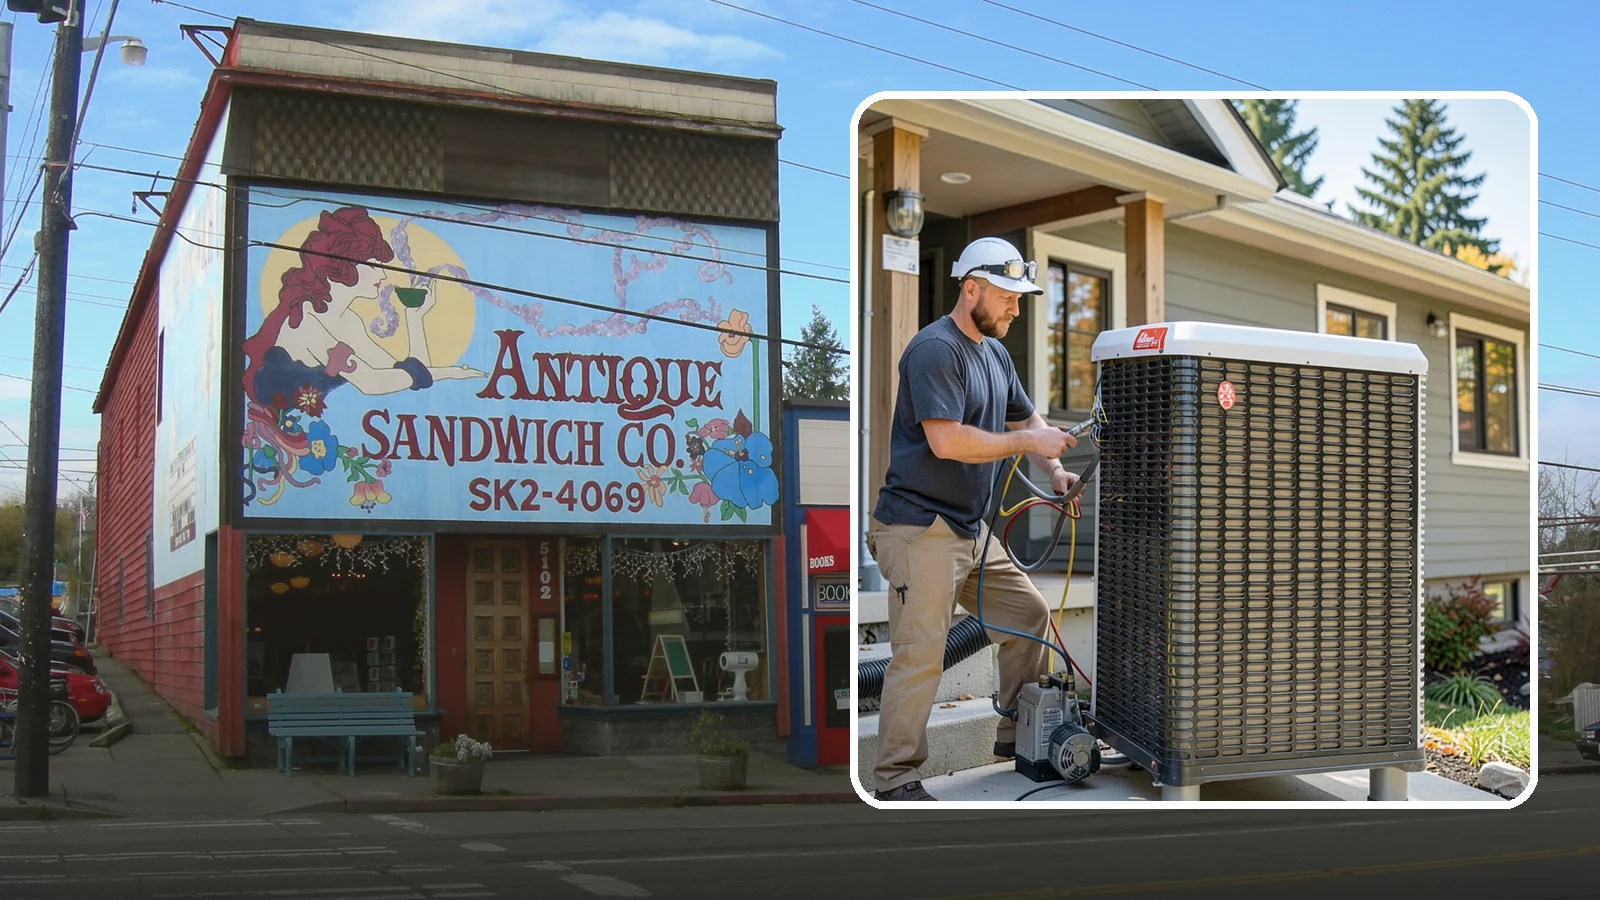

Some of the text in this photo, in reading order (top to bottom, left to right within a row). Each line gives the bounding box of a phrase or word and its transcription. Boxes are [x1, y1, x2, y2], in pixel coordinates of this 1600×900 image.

[476, 329, 723, 421] ANTIQUE
[362, 409, 685, 469] SANDWICH CO.
[469, 478, 646, 513] SK2-4069
[540, 542, 551, 599] 5102
[809, 555, 835, 569] BOOKS
